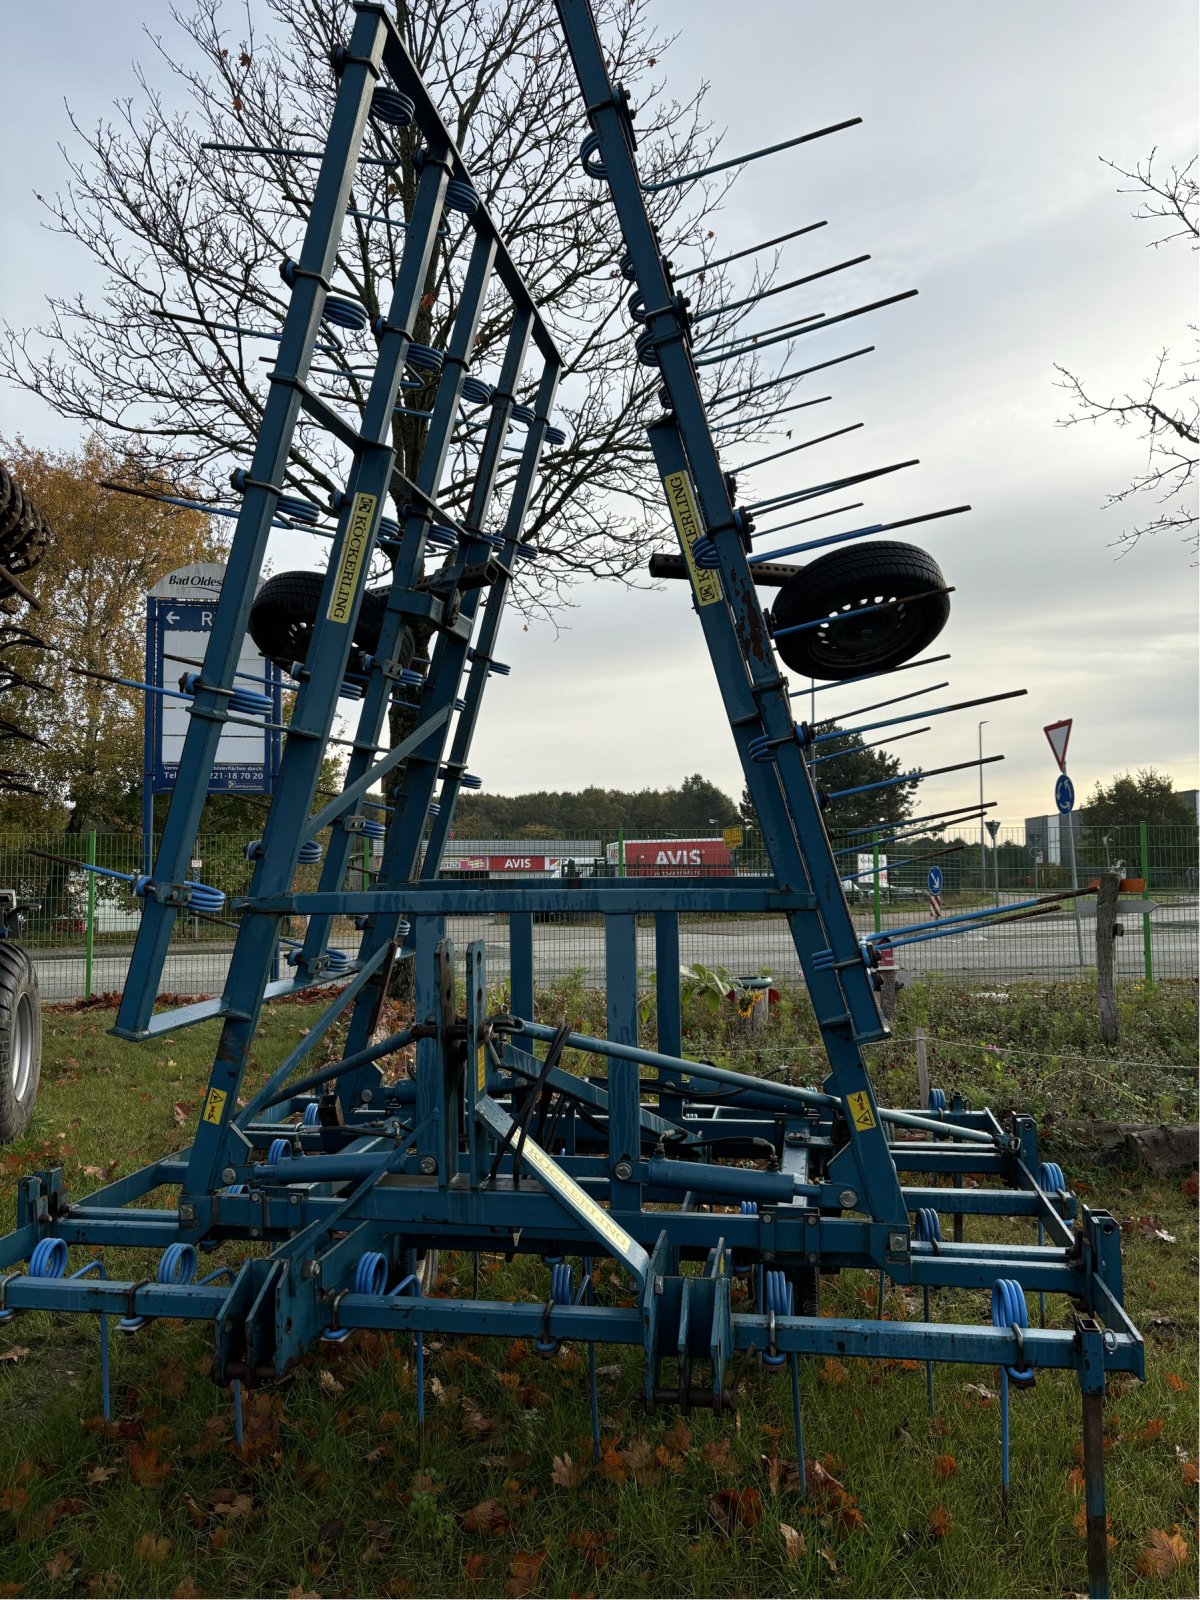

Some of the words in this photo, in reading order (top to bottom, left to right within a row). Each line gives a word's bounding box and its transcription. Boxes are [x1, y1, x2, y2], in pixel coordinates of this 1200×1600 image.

[333, 514, 368, 620] KÖCKERLING
[169, 575, 190, 586] Bad
[190, 575, 223, 587] Oldes
[504, 858, 532, 869] AVIS
[654, 849, 701, 865] AVIS
